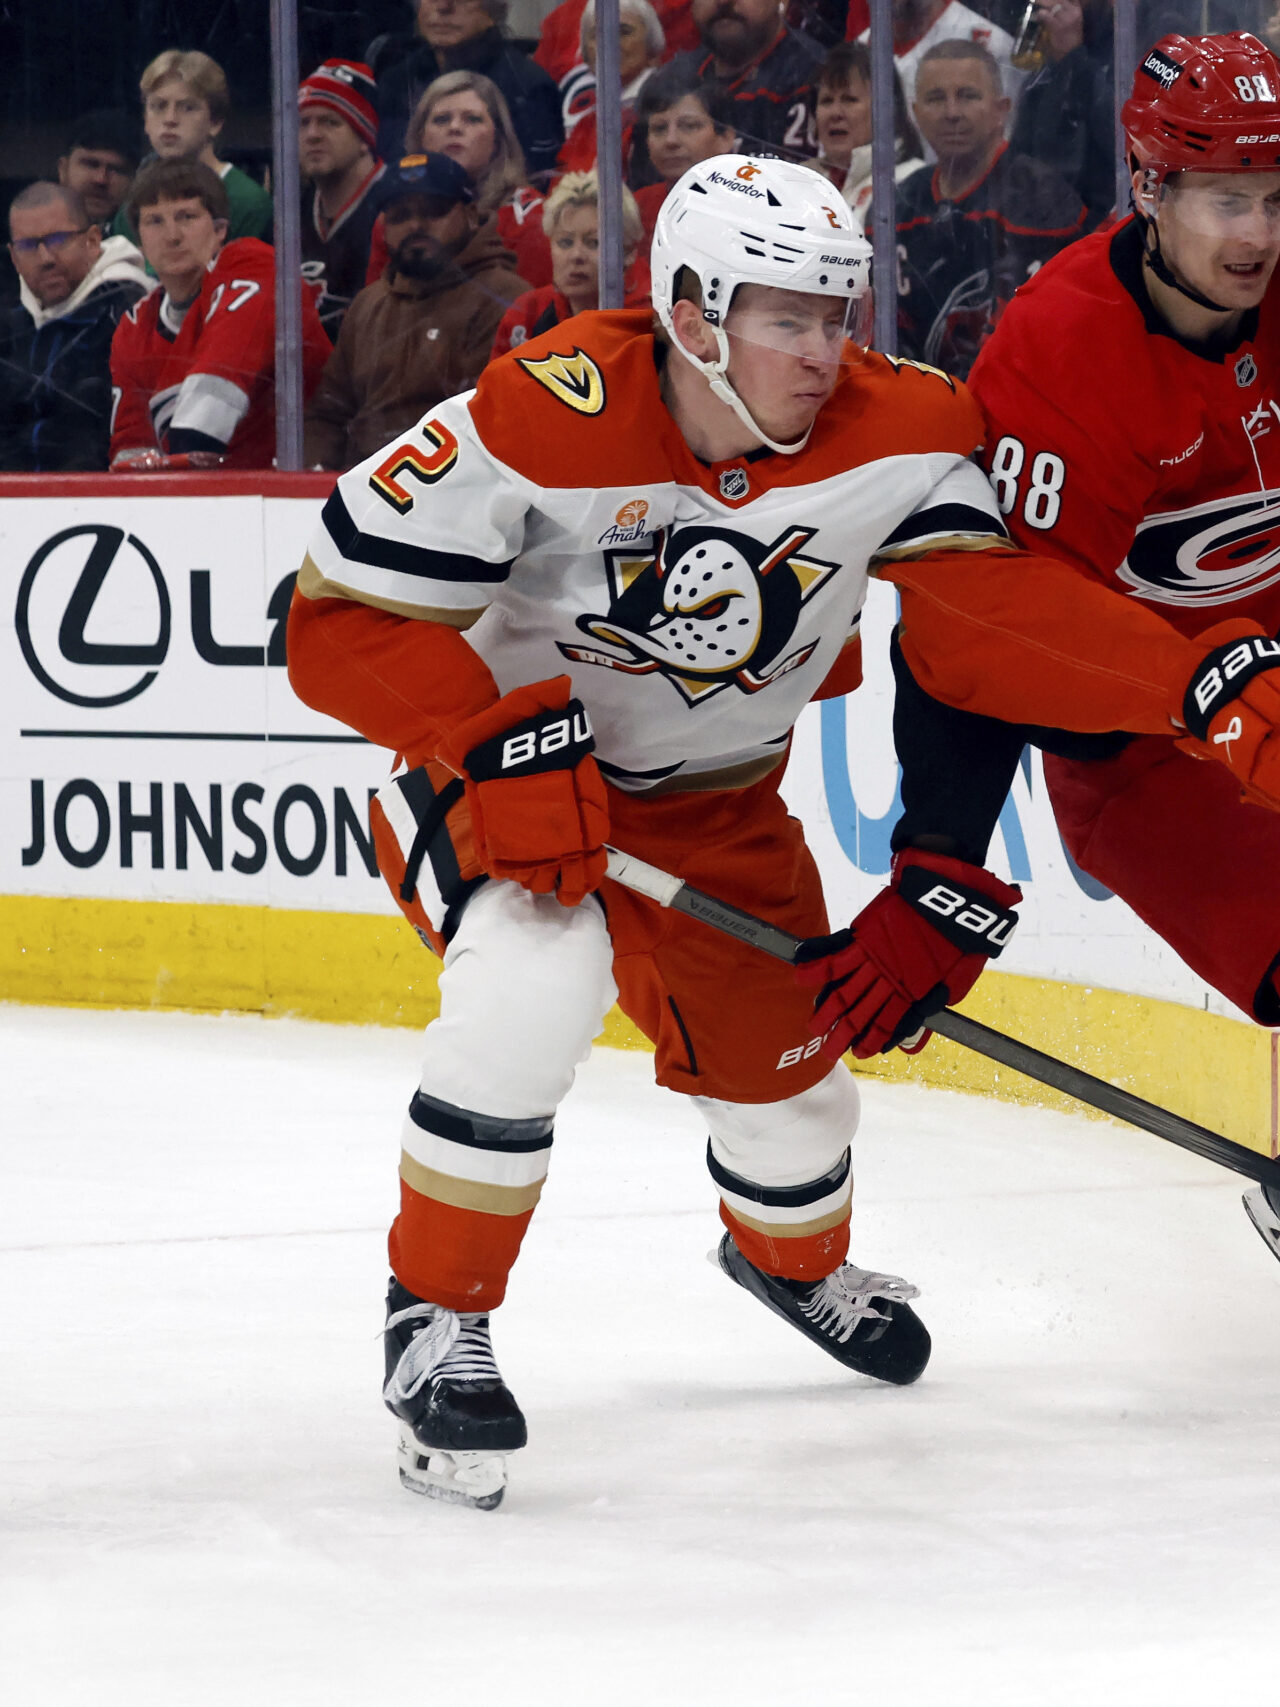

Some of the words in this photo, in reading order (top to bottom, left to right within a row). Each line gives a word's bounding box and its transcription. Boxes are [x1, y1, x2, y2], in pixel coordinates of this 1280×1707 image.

[706, 171, 766, 199] Navigator
[820, 255, 862, 267] BAUER
[369, 419, 459, 516] 2
[988, 435, 1065, 530] 88
[21, 778, 381, 878] JOHNSON
